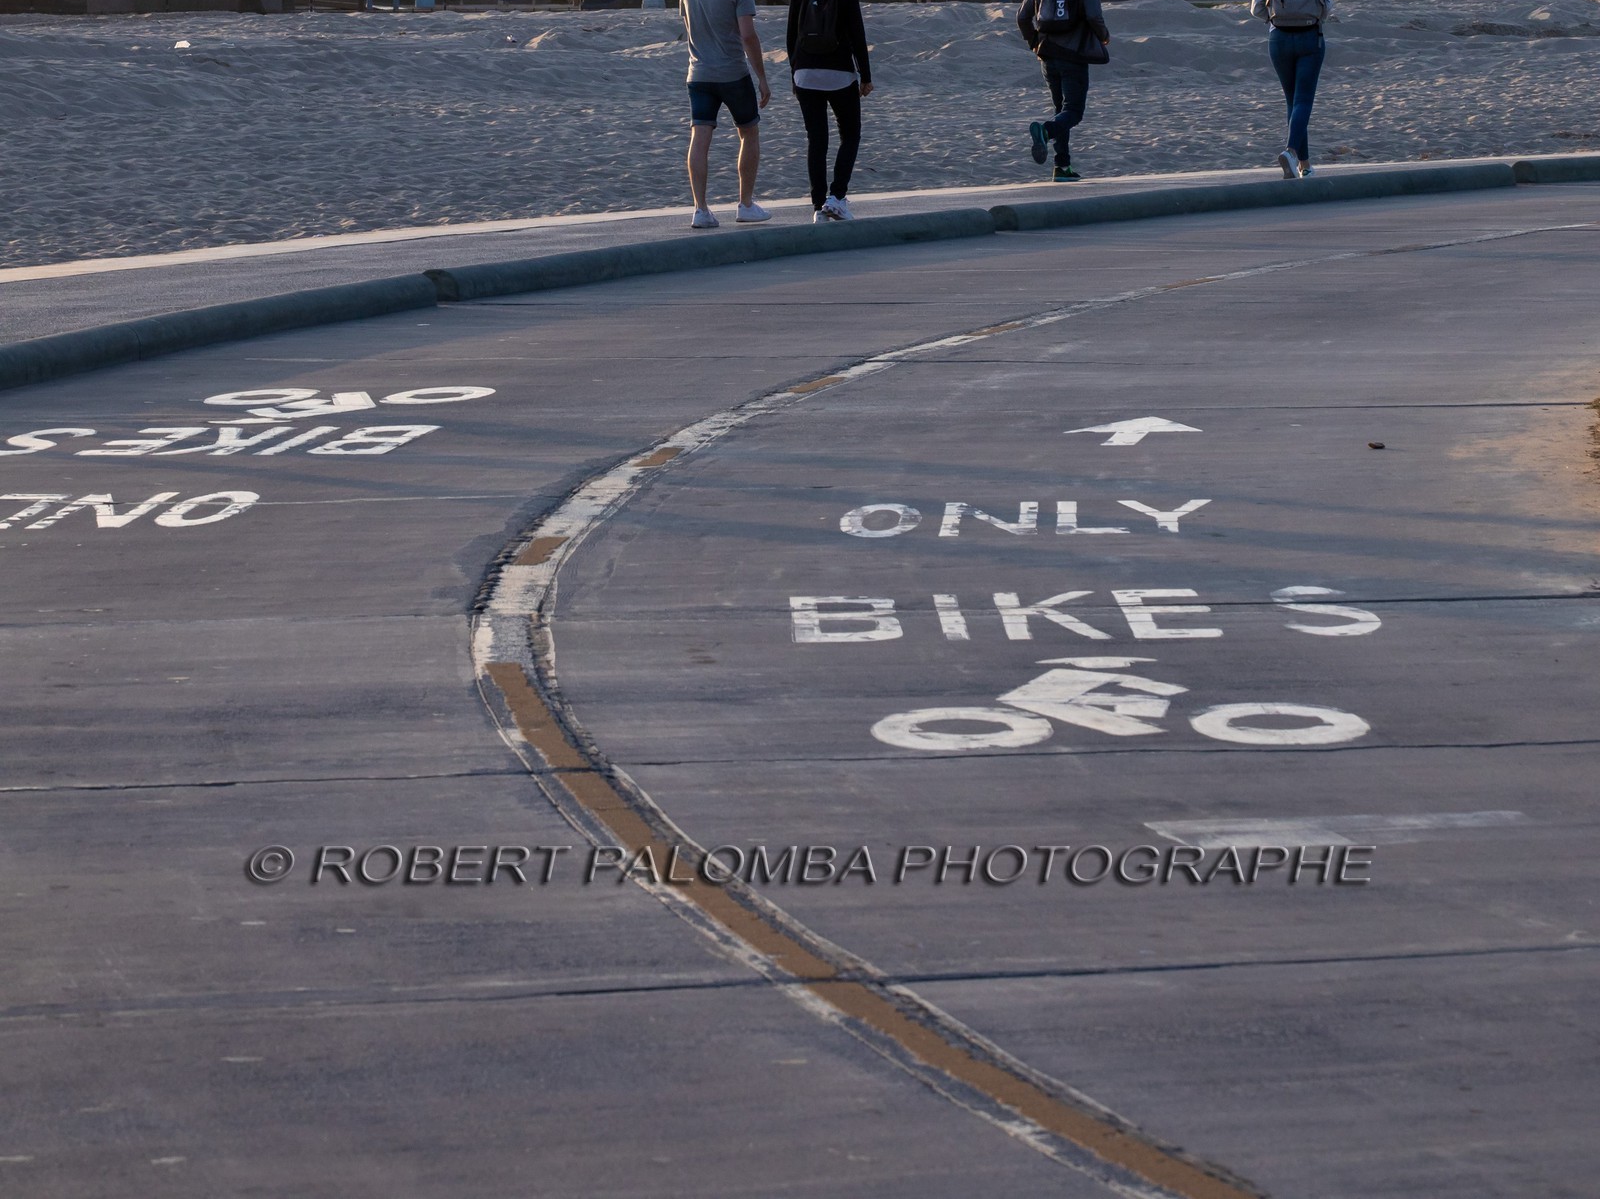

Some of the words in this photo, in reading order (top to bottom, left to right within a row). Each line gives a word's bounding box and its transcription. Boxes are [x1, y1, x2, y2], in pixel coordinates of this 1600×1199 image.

[0, 425, 442, 456] BIKES
[839, 499, 1212, 538] ONLY
[789, 586, 1382, 643] BIKES
